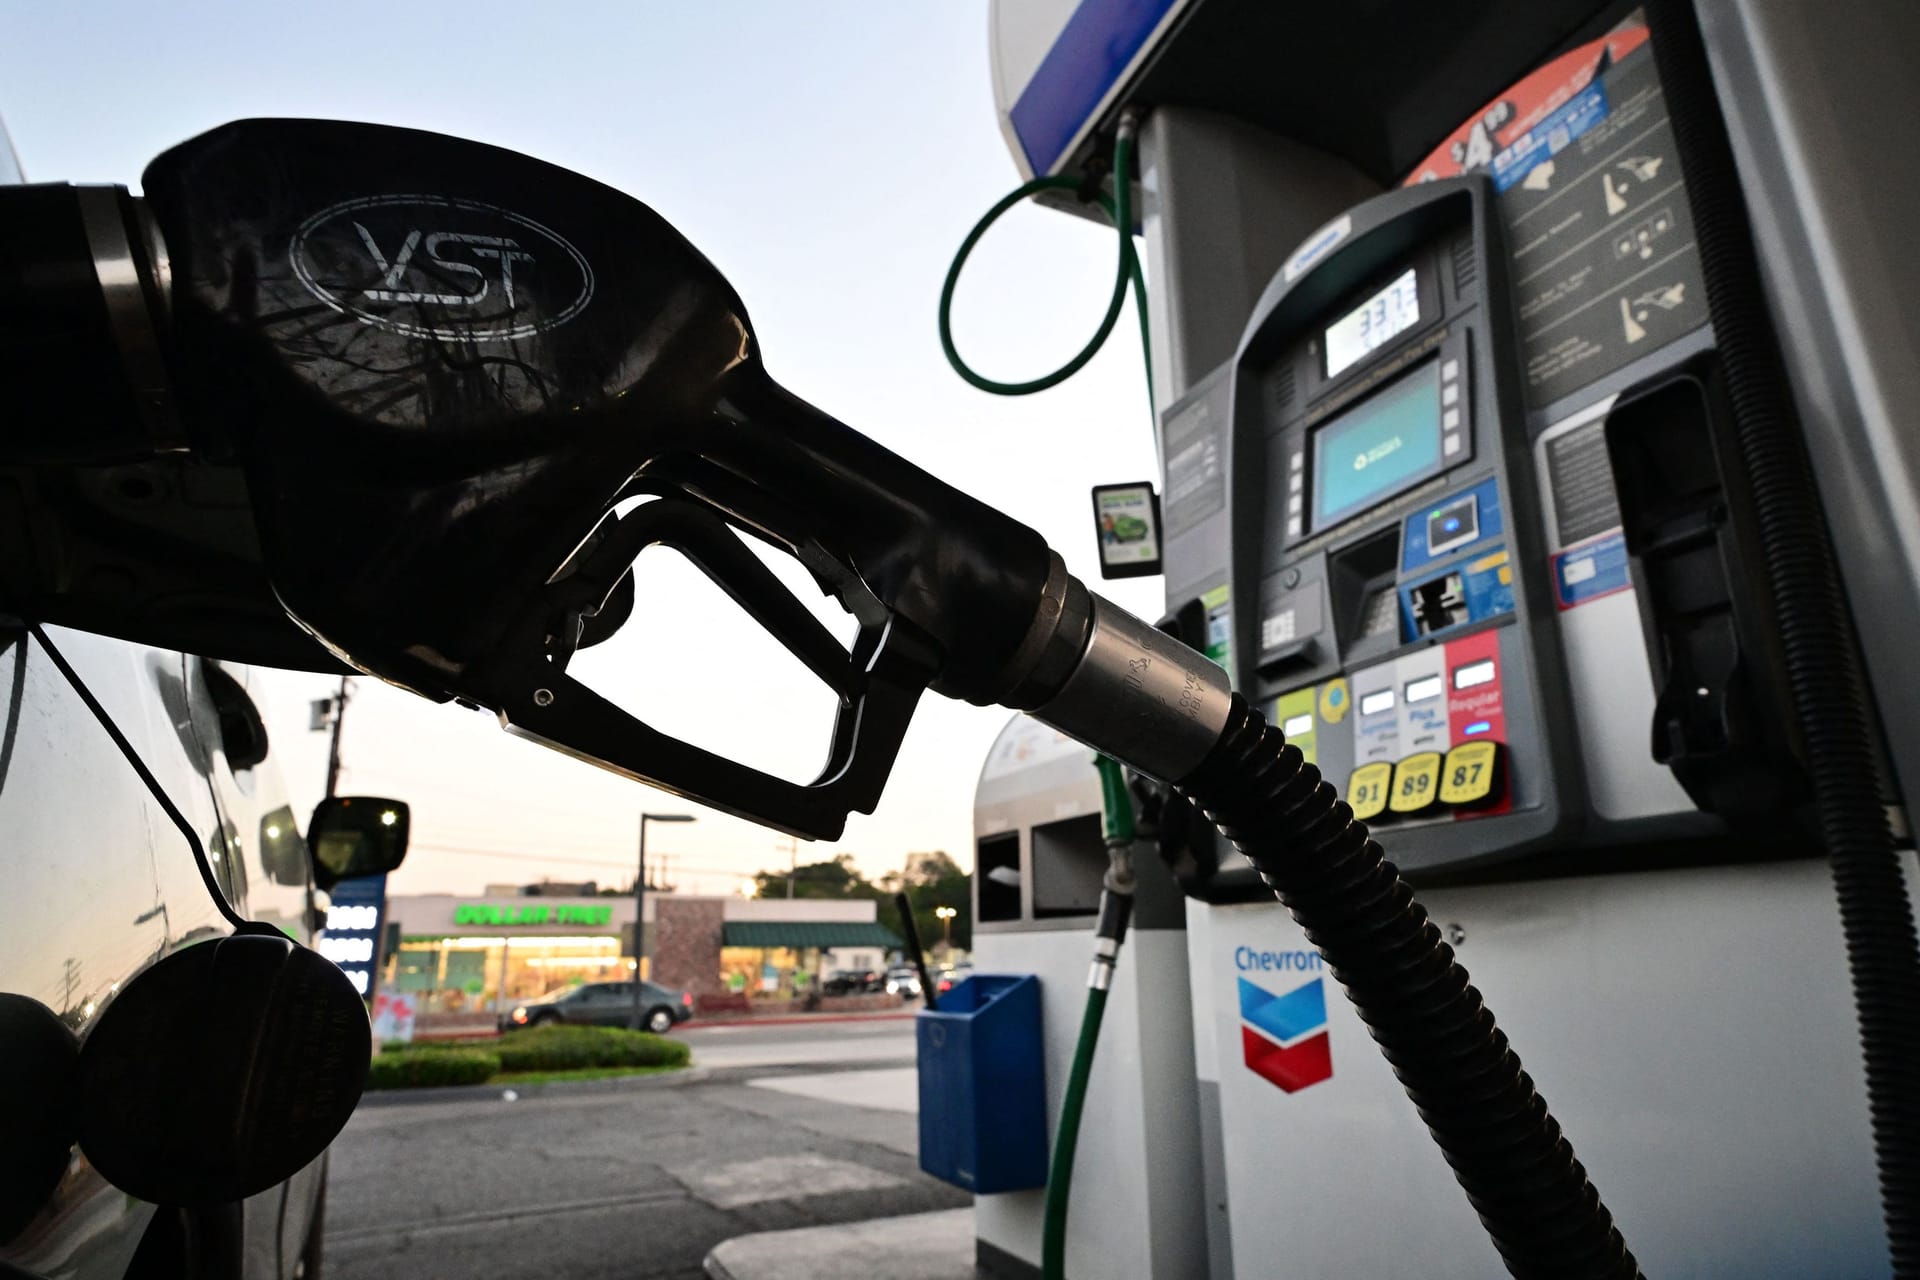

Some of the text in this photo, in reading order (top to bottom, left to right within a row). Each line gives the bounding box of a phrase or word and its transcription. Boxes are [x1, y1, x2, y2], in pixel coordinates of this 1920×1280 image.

[352, 220, 537, 310] VST
[1402, 773, 1429, 797] 89
[1453, 763, 1483, 787] 87
[1356, 783, 1380, 804] 91
[455, 904, 613, 925] DOLLAR TREE
[1235, 946, 1322, 970] Chevron
